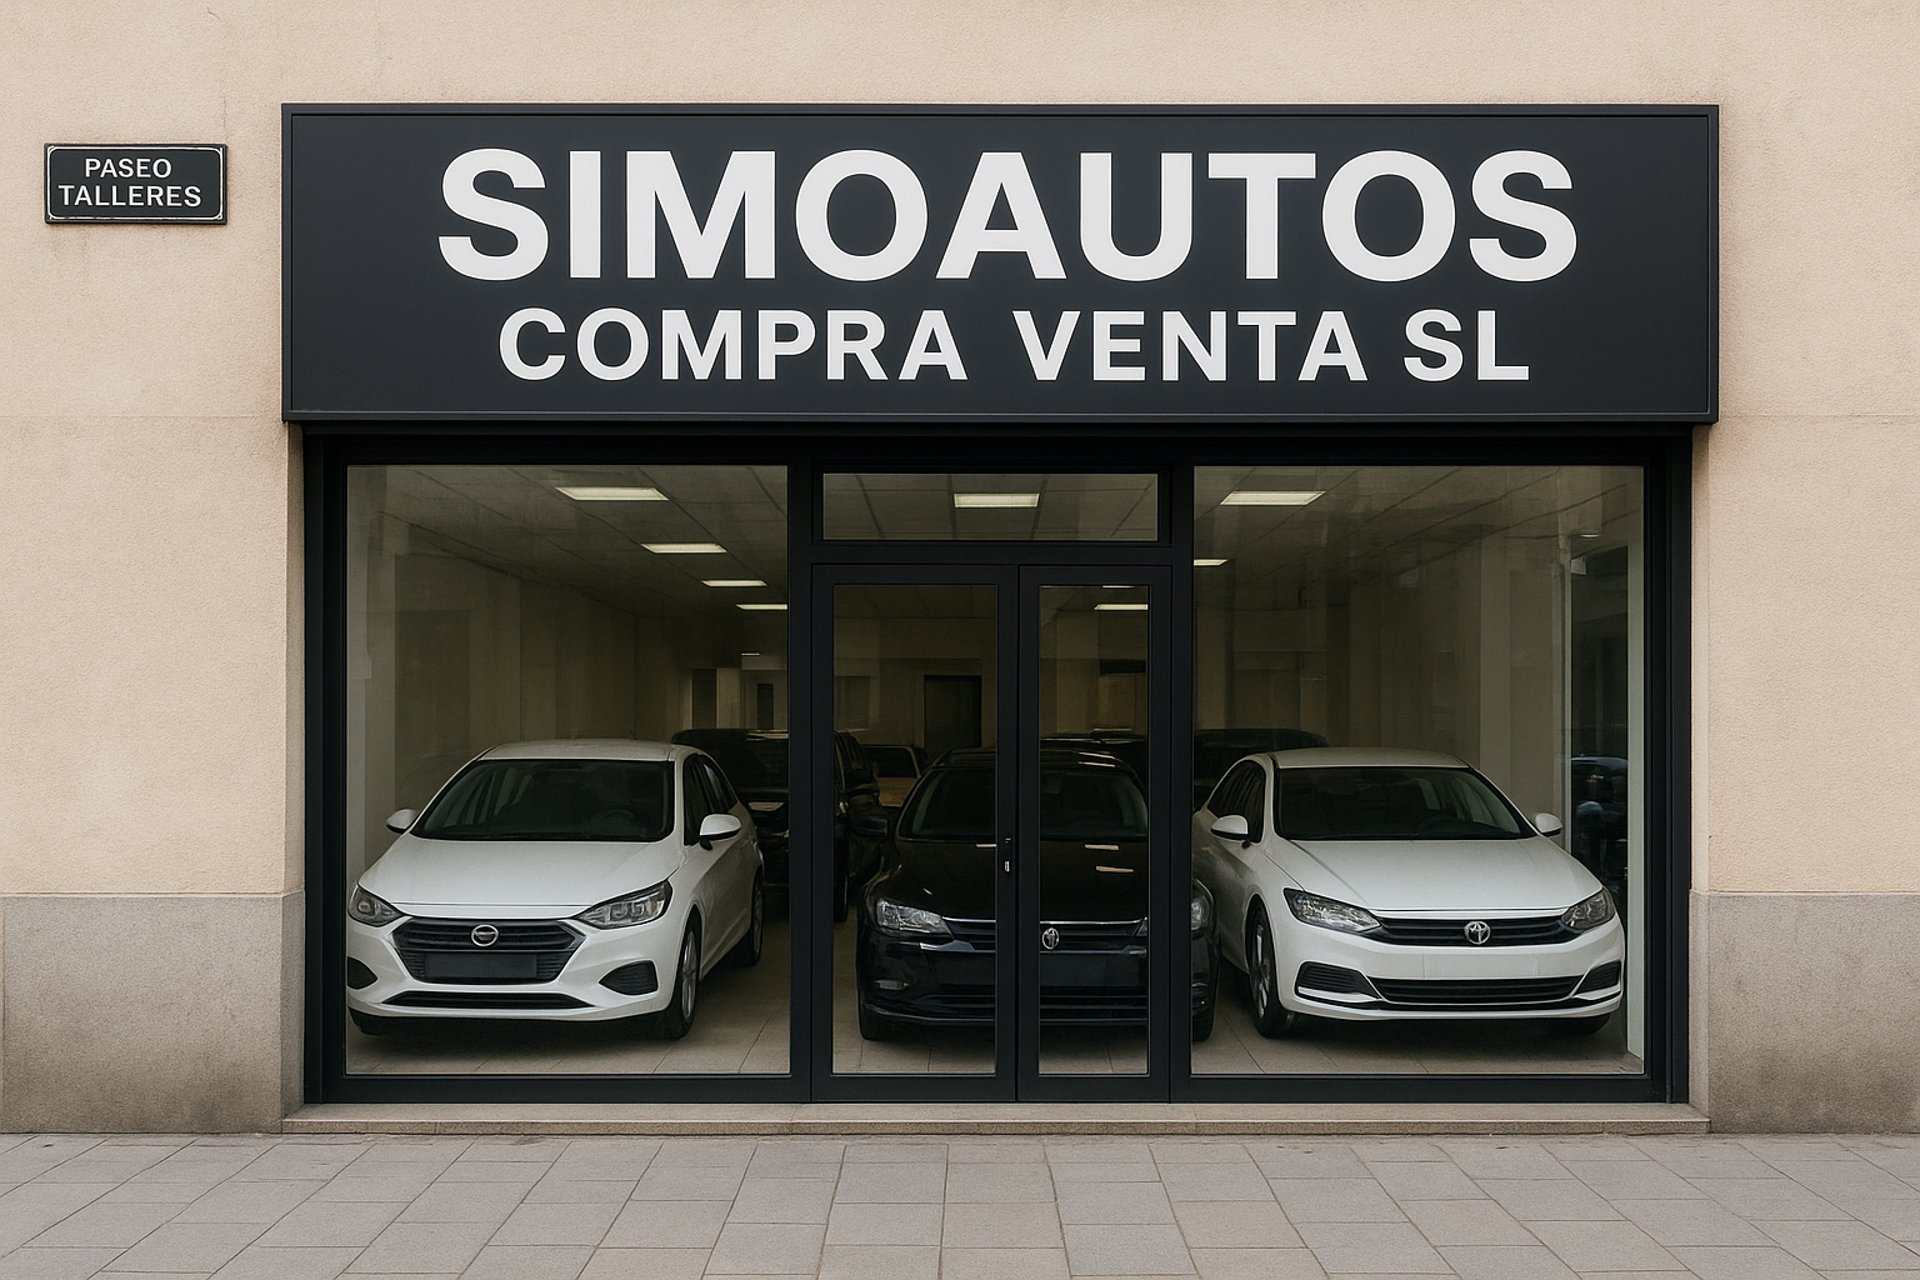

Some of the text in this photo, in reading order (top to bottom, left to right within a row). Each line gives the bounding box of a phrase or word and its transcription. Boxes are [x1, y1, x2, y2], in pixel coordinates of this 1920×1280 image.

[85, 158, 172, 179] PASEO
[58, 184, 201, 207] TALLERES
[438, 148, 1577, 282] SIMOAUTOS
[499, 307, 1530, 382] COMPRA VENTA SL
